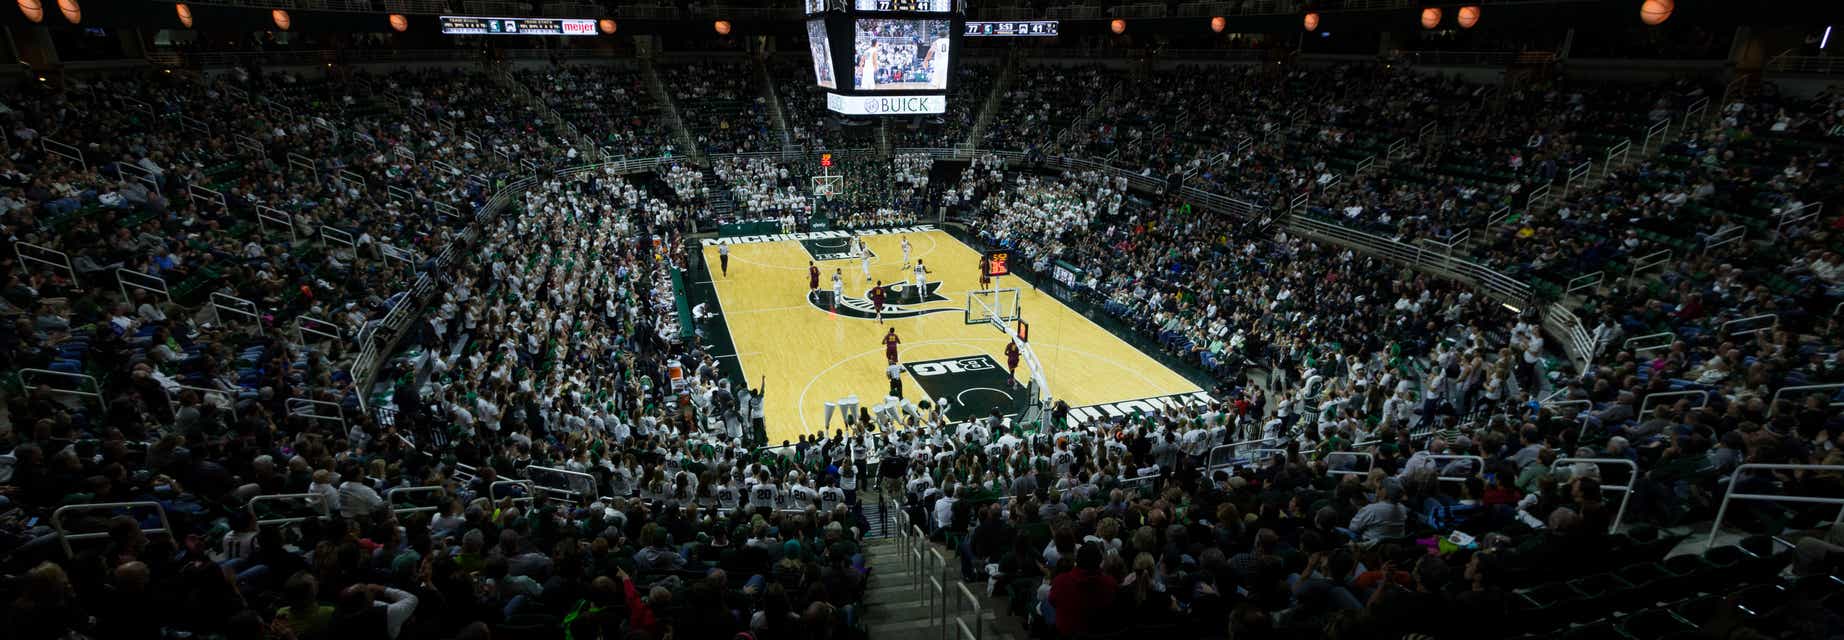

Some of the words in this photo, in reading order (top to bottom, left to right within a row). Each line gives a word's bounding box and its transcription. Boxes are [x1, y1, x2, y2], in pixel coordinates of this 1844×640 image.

[880, 2, 889, 10] 77
[918, 2, 928, 10] 41
[564, 21, 594, 33] meijer
[968, 25, 978, 33] 77
[1032, 25, 1043, 33] 41
[881, 97, 928, 112] BUICK
[702, 229, 851, 247] MICHIGAN
[1058, 453, 1071, 464] 20
[916, 481, 930, 493] 20
[719, 490, 732, 500] 20
[757, 489, 772, 500] 20
[793, 489, 807, 501] 20
[822, 491, 837, 502] 20
